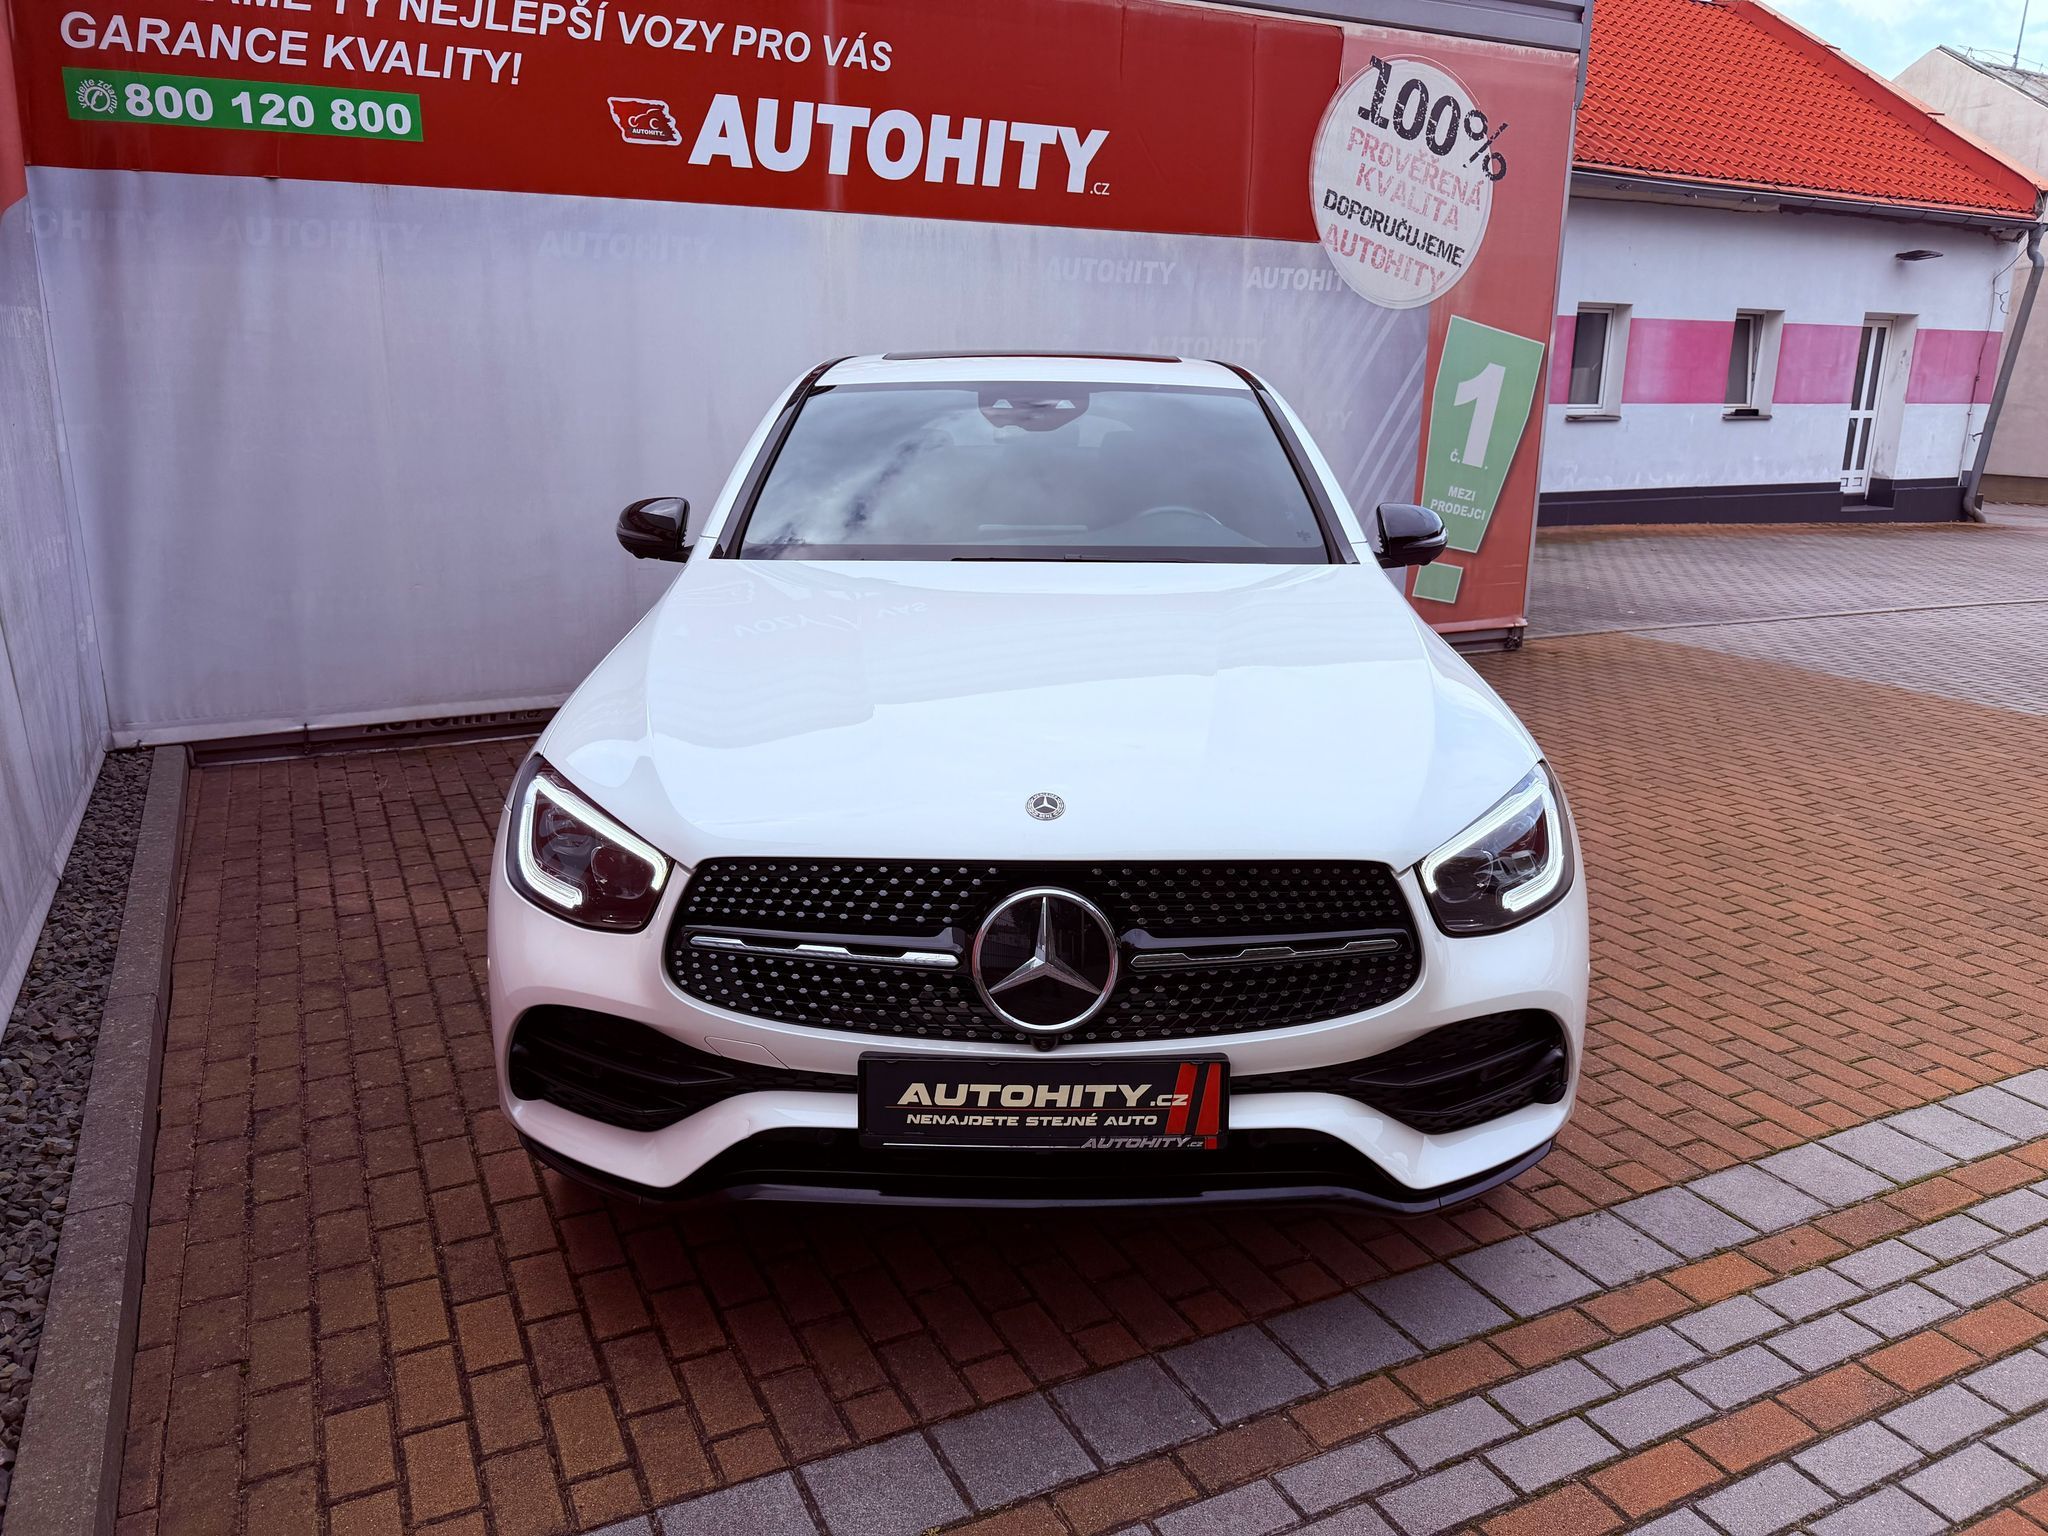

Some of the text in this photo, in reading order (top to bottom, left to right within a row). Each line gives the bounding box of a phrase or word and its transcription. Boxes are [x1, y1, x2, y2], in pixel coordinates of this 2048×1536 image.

[60, 11, 522, 86] GARANCE KVALITY!
[399, 0, 608, 42] NEJLEPŠÍ
[617, 11, 725, 54] VOZY
[732, 25, 812, 64] PRO
[823, 32, 893, 72] VÁS
[75, 79, 118, 114] volejte zdarma
[124, 83, 412, 135] 800 120 800
[1357, 55, 1509, 181] 100%
[1346, 126, 1485, 212] PROVĚŘENÁ
[1354, 162, 1460, 231] KVALITA
[1323, 188, 1466, 268] DOPORUČUJEME
[1324, 223, 1446, 293] AUTOHITY
[1046, 255, 1176, 286] AUTOHITY
[1245, 265, 1343, 293] AUTOHIT
[1430, 499, 1486, 521] PRODEJCI
[1448, 486, 1477, 502] MEZI
[906, 1112, 1158, 1128] NENAJDETE STEJNÉ AUTO
